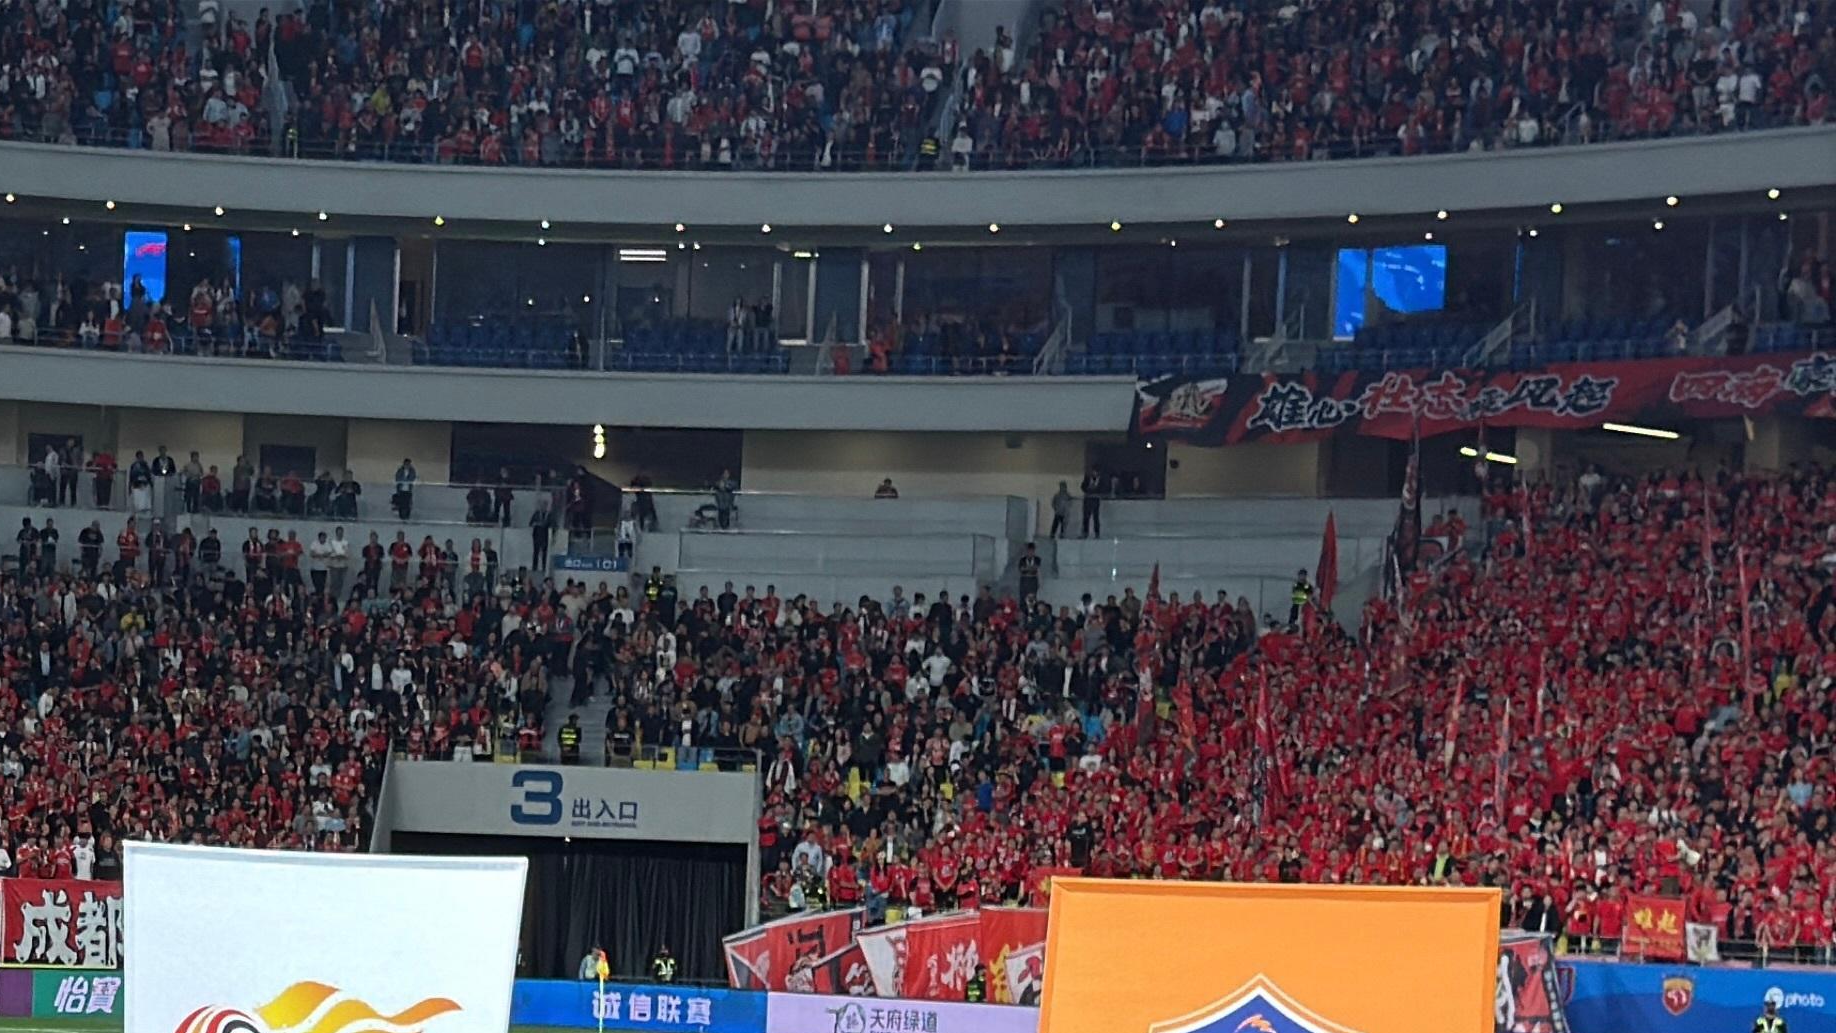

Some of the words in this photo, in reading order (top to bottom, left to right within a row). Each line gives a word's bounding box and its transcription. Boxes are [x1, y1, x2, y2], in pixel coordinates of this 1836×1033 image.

[510, 770, 563, 825] 3
[571, 797, 638, 820] 出入口
[14, 889, 123, 967] 成都
[592, 991, 711, 1026] 诚信联赛
[1785, 991, 1825, 1008] photo
[870, 1007, 937, 1033] 天府绿道
